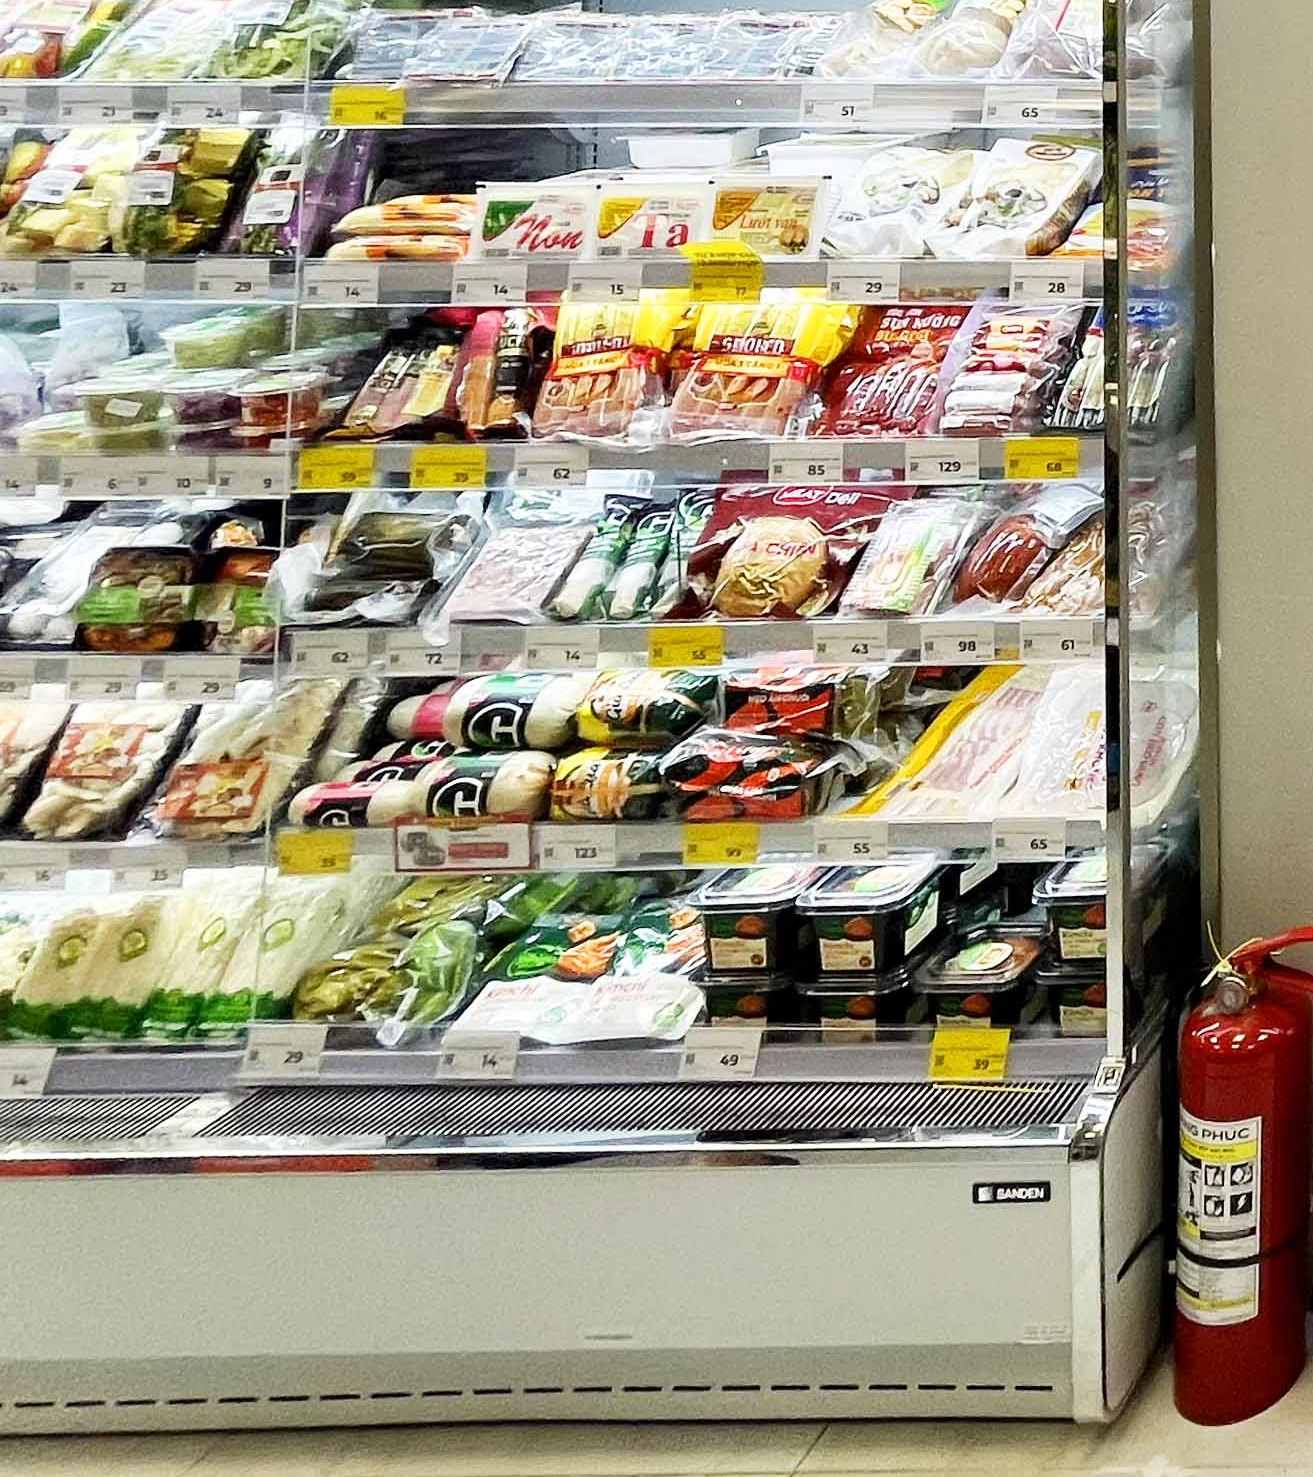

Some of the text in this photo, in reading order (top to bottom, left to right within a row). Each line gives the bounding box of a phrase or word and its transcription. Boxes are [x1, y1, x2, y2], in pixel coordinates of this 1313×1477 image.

[841, 106, 854, 116] 51
[513, 212, 583, 252] Non
[234, 280, 252, 292] 29
[610, 284, 623, 295] 15
[1048, 281, 1064, 293] 28
[938, 461, 961, 473] 129
[553, 468, 570, 480] 62
[263, 478, 272, 489] 9
[851, 643, 869, 655] 43
[958, 640, 976, 653] 98
[425, 652, 443, 665] 72
[854, 842, 871, 853] 55
[720, 1053, 738, 1066] 49
[996, 1187, 1044, 1200] SANDEN
